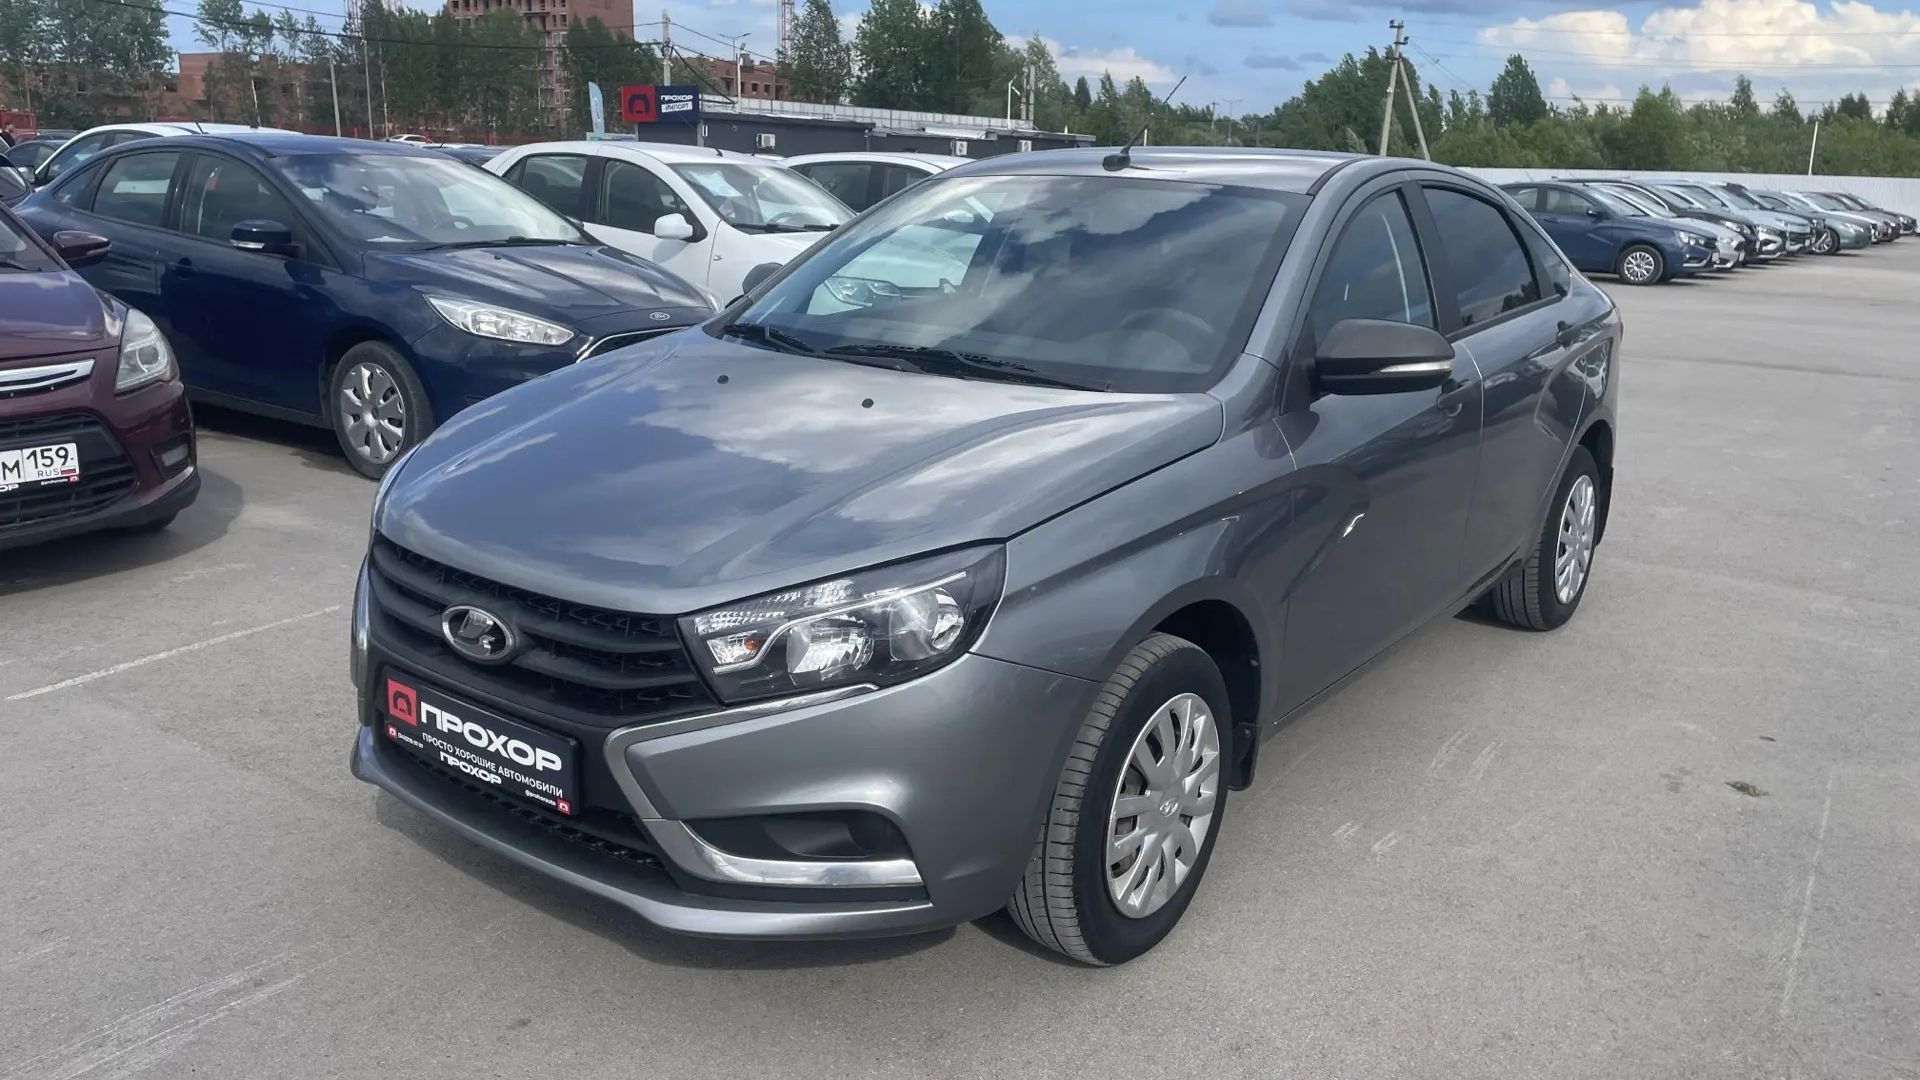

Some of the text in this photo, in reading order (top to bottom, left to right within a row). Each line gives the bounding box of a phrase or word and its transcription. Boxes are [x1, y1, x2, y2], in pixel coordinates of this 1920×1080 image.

[665, 102, 689, 111] ИМПОРТ
[26, 446, 69, 470] 159
[38, 468, 60, 478] RUS
[420, 701, 562, 771] ПРОХОР
[422, 732, 454, 754] ПРОСТО
[454, 746, 497, 772] ХОРОШИЕ
[498, 765, 564, 798] АВТОМОБИЛИ
[439, 751, 502, 785] ПРОХОР
